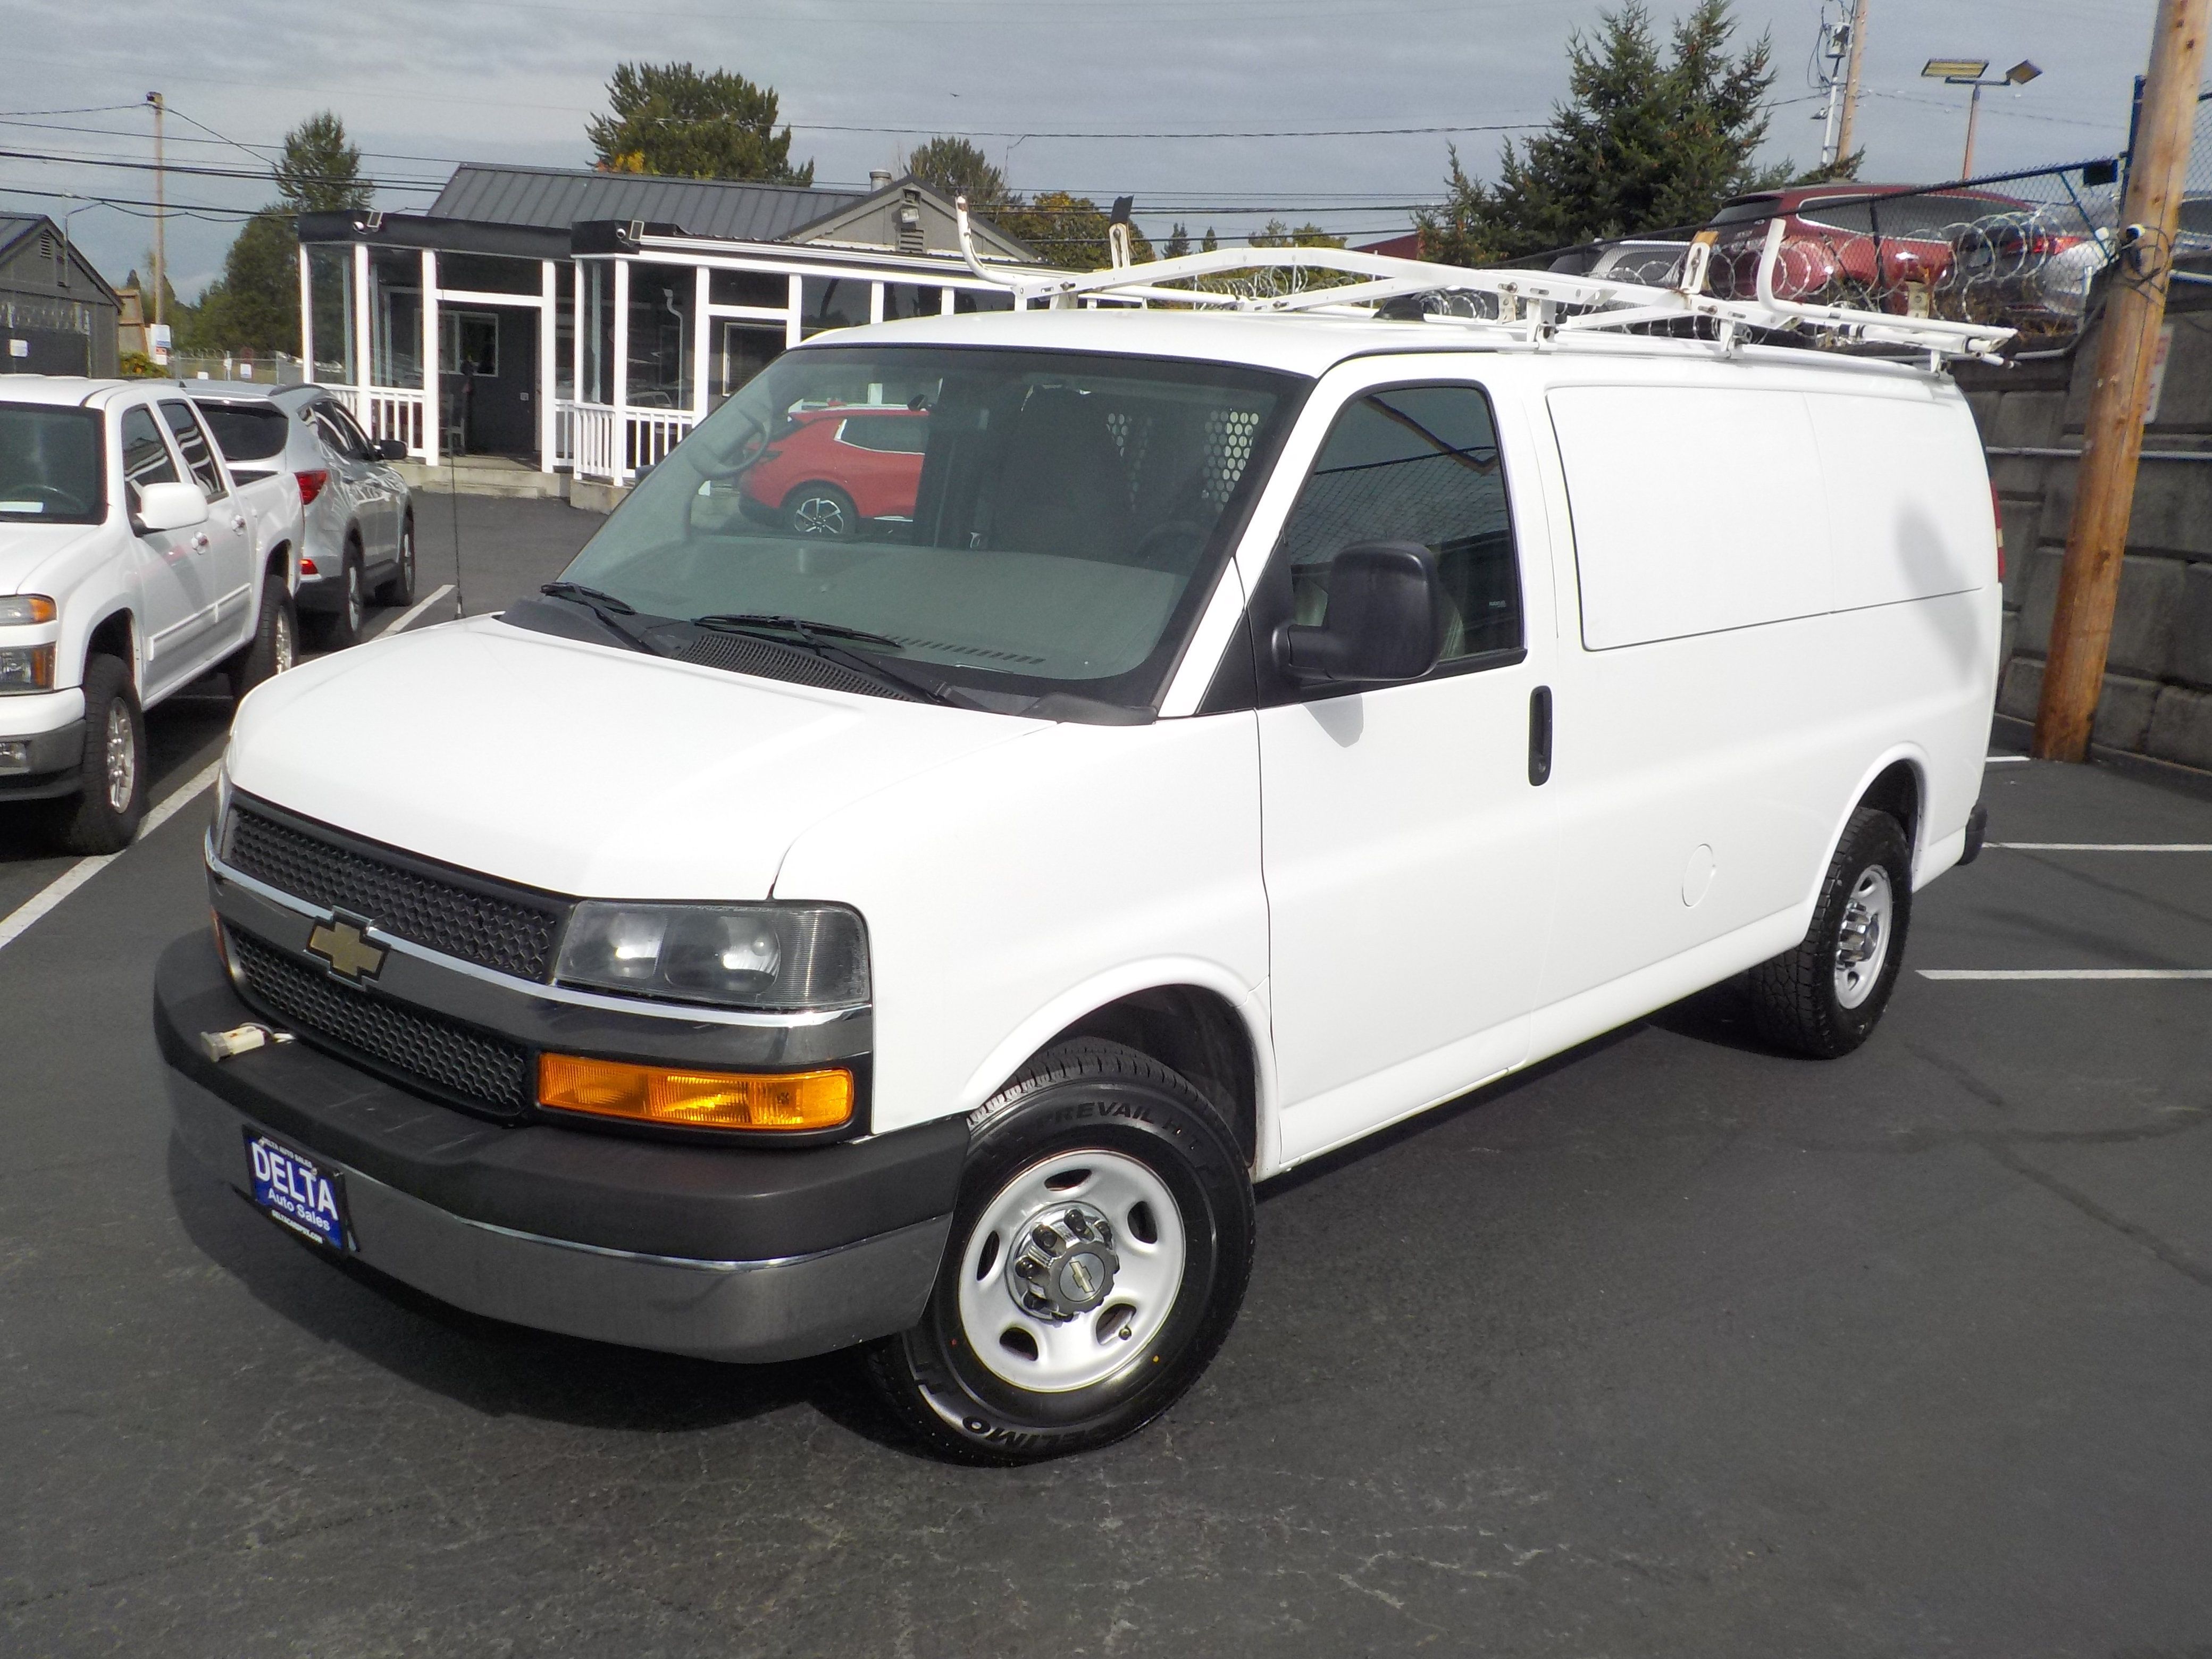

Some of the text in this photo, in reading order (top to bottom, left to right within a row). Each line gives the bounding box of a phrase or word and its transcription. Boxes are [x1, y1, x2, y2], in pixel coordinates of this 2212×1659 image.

[1037, 1101, 1153, 1126] PREVAIL
[251, 1141, 338, 1221] DELTA
[268, 1188, 330, 1231] Auto Sales
